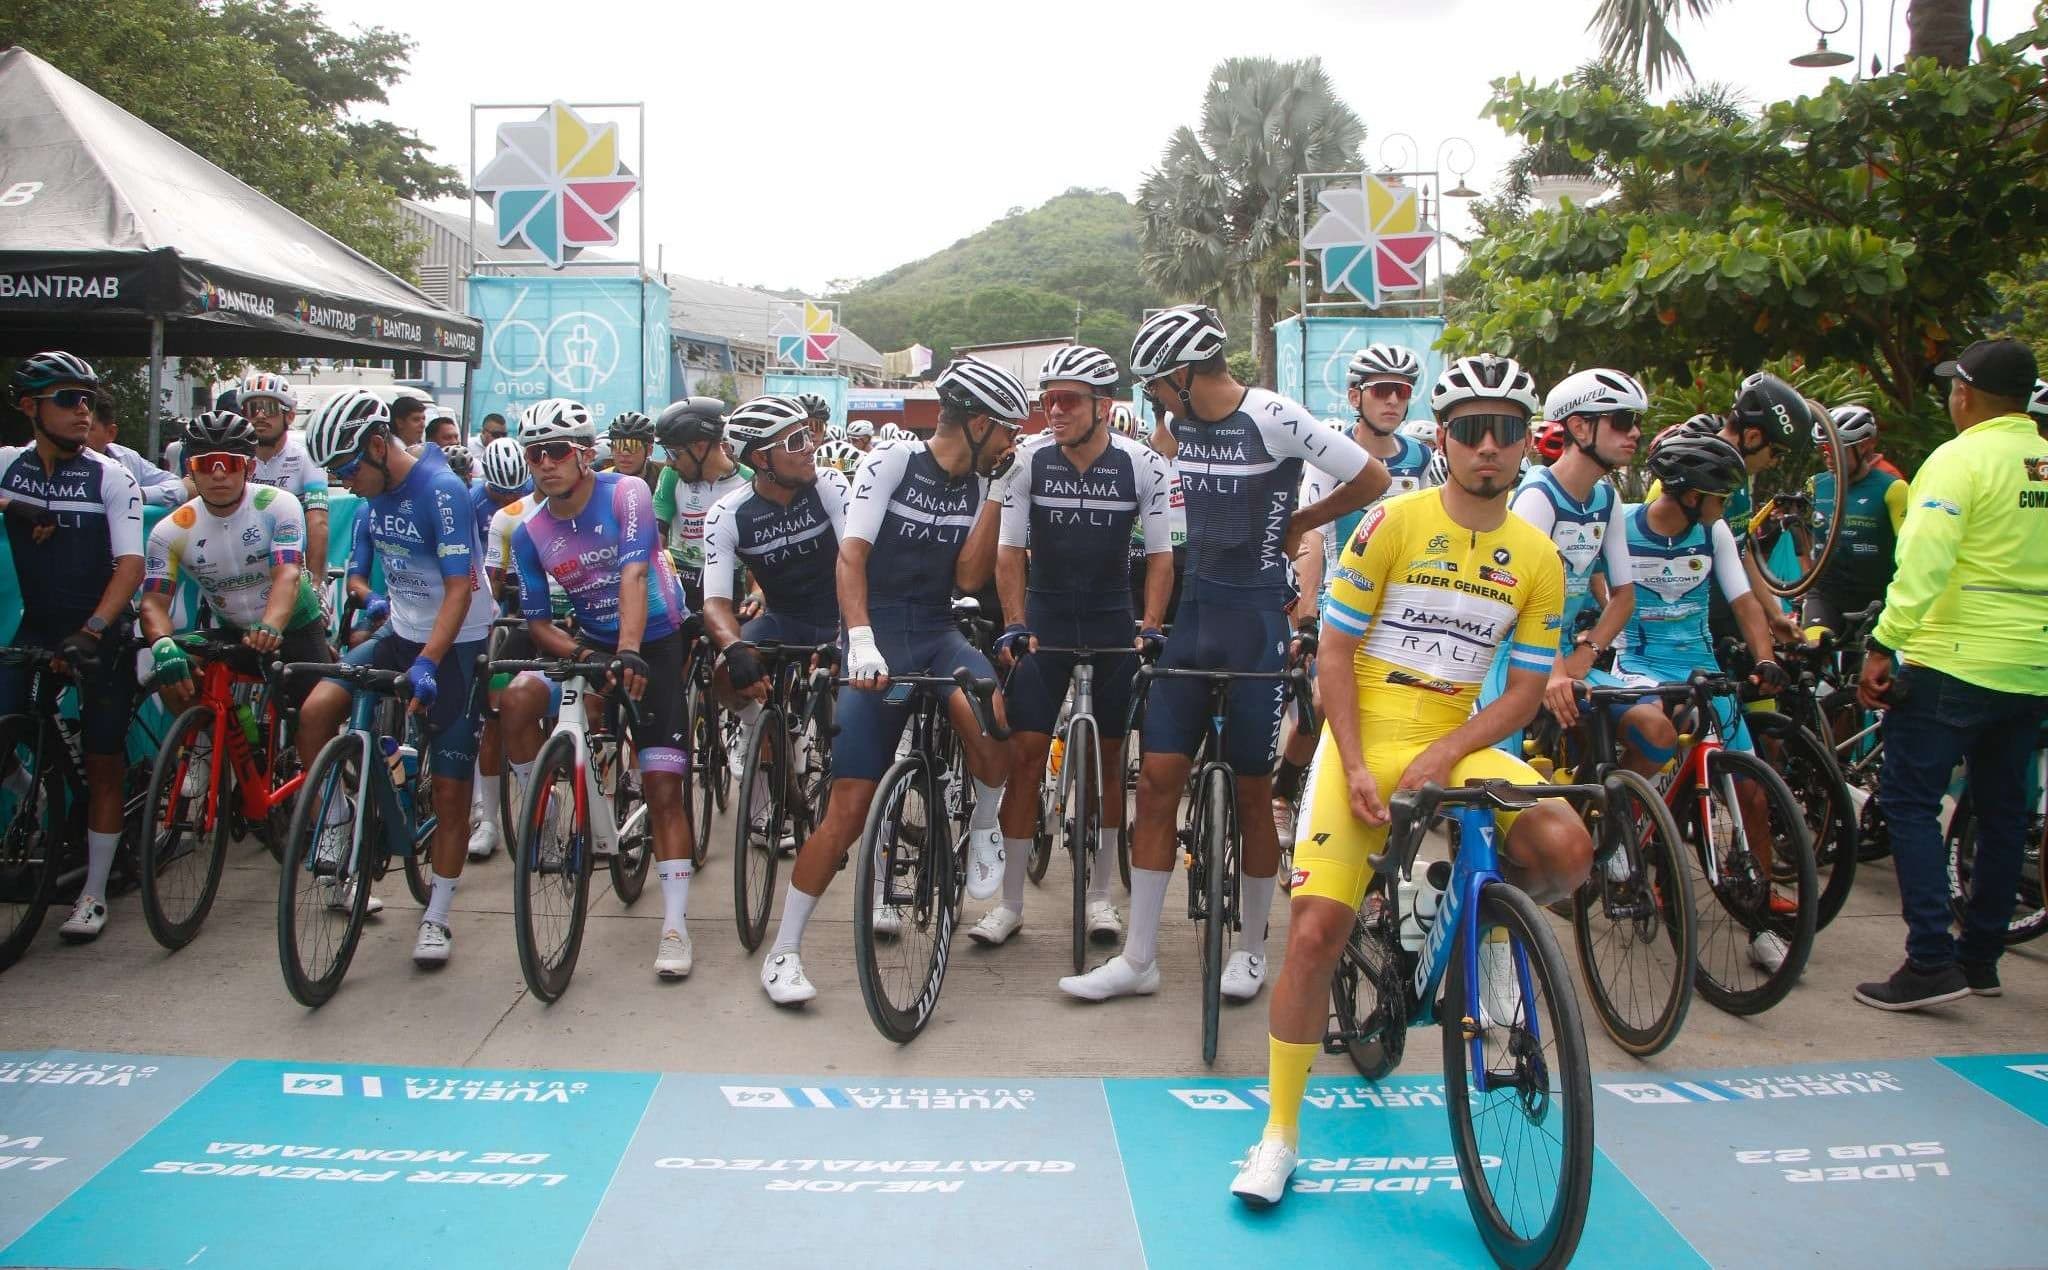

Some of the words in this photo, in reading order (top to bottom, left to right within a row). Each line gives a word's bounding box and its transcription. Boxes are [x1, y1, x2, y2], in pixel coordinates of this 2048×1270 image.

[0, 275, 119, 298] BANTRAB
[217, 287, 275, 319] BANTRAB
[309, 305, 356, 331] BANTRAB
[383, 319, 422, 342] BANTRAB
[443, 331, 476, 351] BANTRAB
[494, 378, 546, 395] años
[1552, 387, 1606, 419] SPECIALIZED
[1265, 400, 1328, 457] RALI
[1771, 403, 1794, 435] POC
[1178, 441, 1246, 461] PANAMÁ
[12, 473, 88, 498] PANAMÁ
[1045, 479, 1120, 498] PANAMÁ
[1182, 474, 1238, 494] RALI
[905, 487, 968, 513] PANAMÁ
[57, 513, 81, 528] LI
[385, 515, 423, 539] ECA
[442, 507, 456, 536] ECA
[682, 519, 705, 527] Anti
[754, 508, 817, 543] PANAMÁ
[1050, 510, 1113, 527] RALI
[682, 527, 705, 535] Anti
[899, 521, 960, 544] RALI
[1260, 491, 1288, 571] PANAMÁ
[764, 539, 819, 566] RALI
[1406, 573, 1451, 588] LÍDER
[1454, 580, 1514, 605] GENERAL
[1402, 607, 1496, 640] PANAMÁ
[1401, 635, 1478, 664] RALI
[1267, 684, 1285, 761] PANAM
[0, 1061, 159, 1072] GUATEMAL
[0, 1068, 133, 1087] VUELT
[293, 1078, 333, 1089] 64
[404, 1077, 590, 1090] GUATEMALA
[406, 1083, 570, 1103] VUELTA
[735, 1091, 776, 1102] 64
[844, 1087, 1034, 1098] GUATEMALA
[1623, 1087, 1662, 1099] 64
[1733, 1078, 1904, 1099] VUELTA
[851, 1096, 1027, 1110] VUELTA
[1189, 1094, 1227, 1105] 64
[205, 1141, 467, 1163] MONTAÑA
[468, 1152, 551, 1164] DE
[1735, 1148, 1811, 1164] 23
[1827, 1141, 1945, 1160] SUB
[140, 1161, 400, 1183] PREMIOS
[653, 1156, 1077, 1174] GUATEMALTECO
[1780, 1161, 1951, 1182] LÍDER
[406, 1170, 569, 1190] LÍDER
[764, 1178, 965, 1194] MEJOR
[1291, 1175, 1465, 1196] LÍDER
